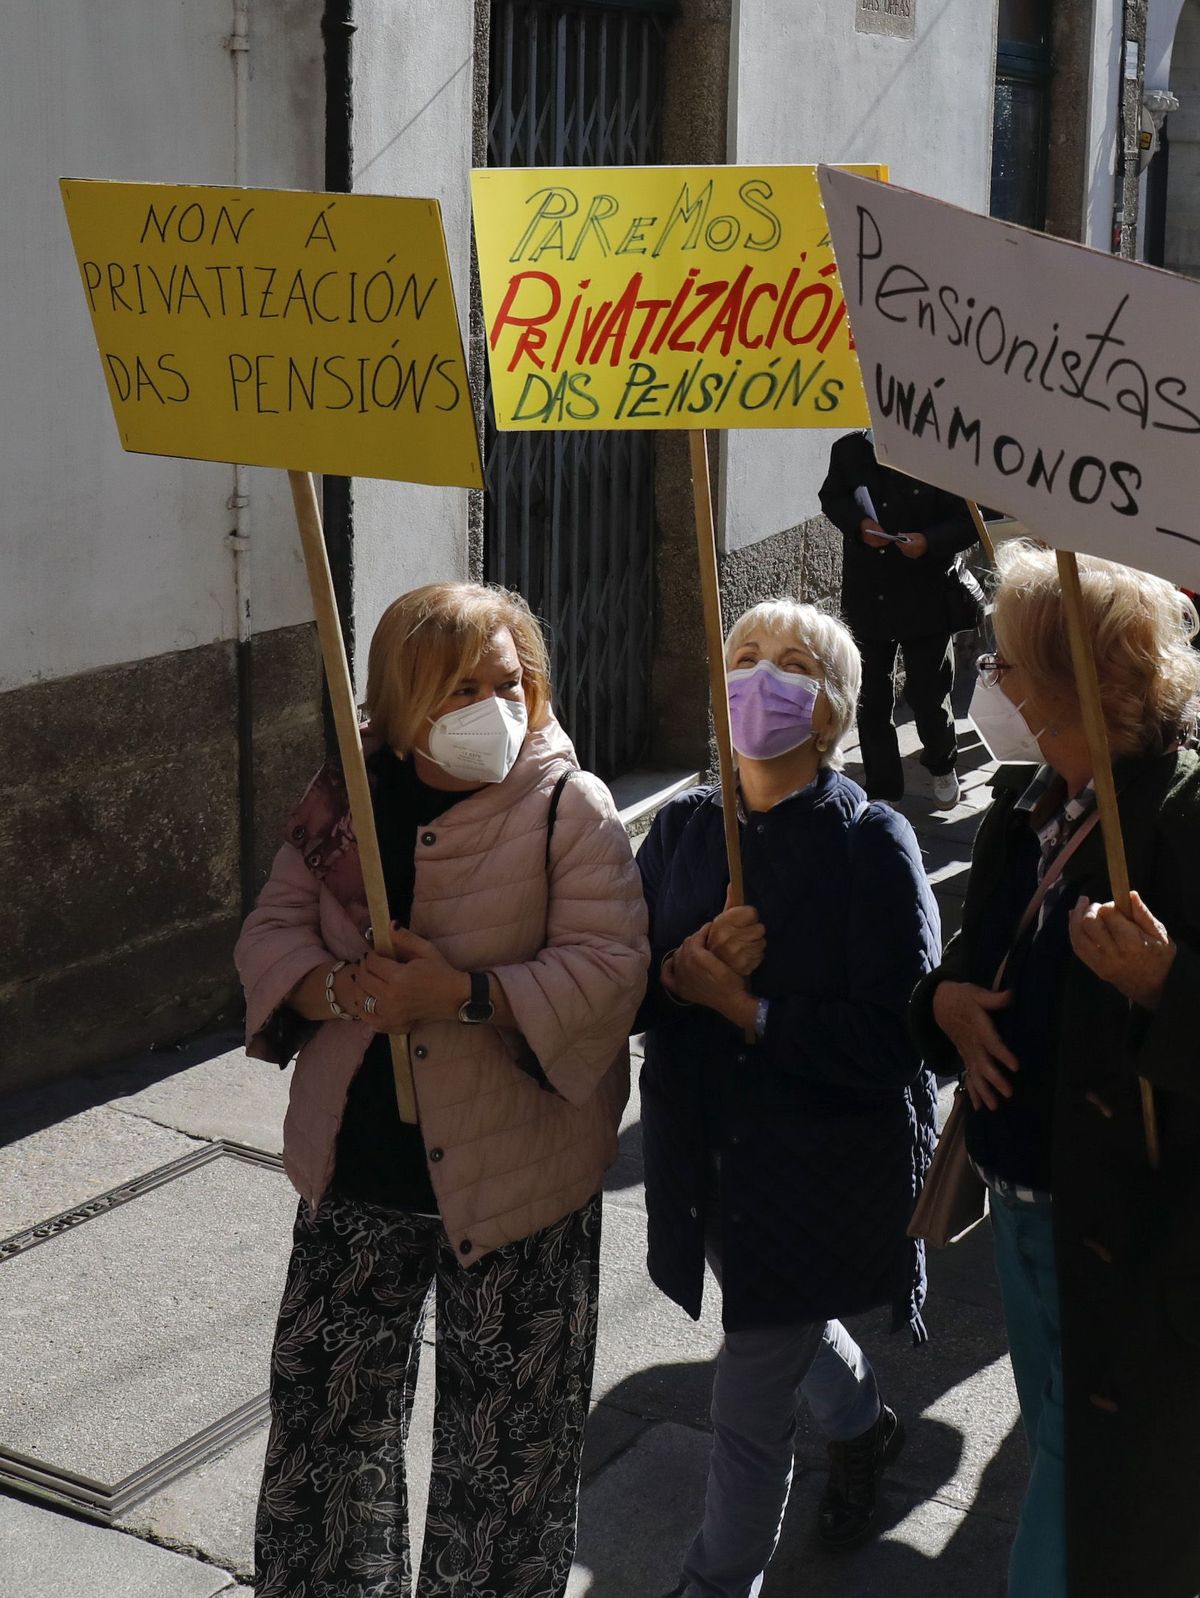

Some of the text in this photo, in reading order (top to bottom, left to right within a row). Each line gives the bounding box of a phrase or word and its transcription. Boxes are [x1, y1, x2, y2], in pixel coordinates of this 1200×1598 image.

[140, 202, 337, 252] NON Á
[83, 253, 438, 325] PRIVATIZACIÓN
[106, 339, 460, 414] DAS PENSIÓNS
[511, 370, 600, 423] DAS
[876, 363, 1142, 517] UNÁMONOS
